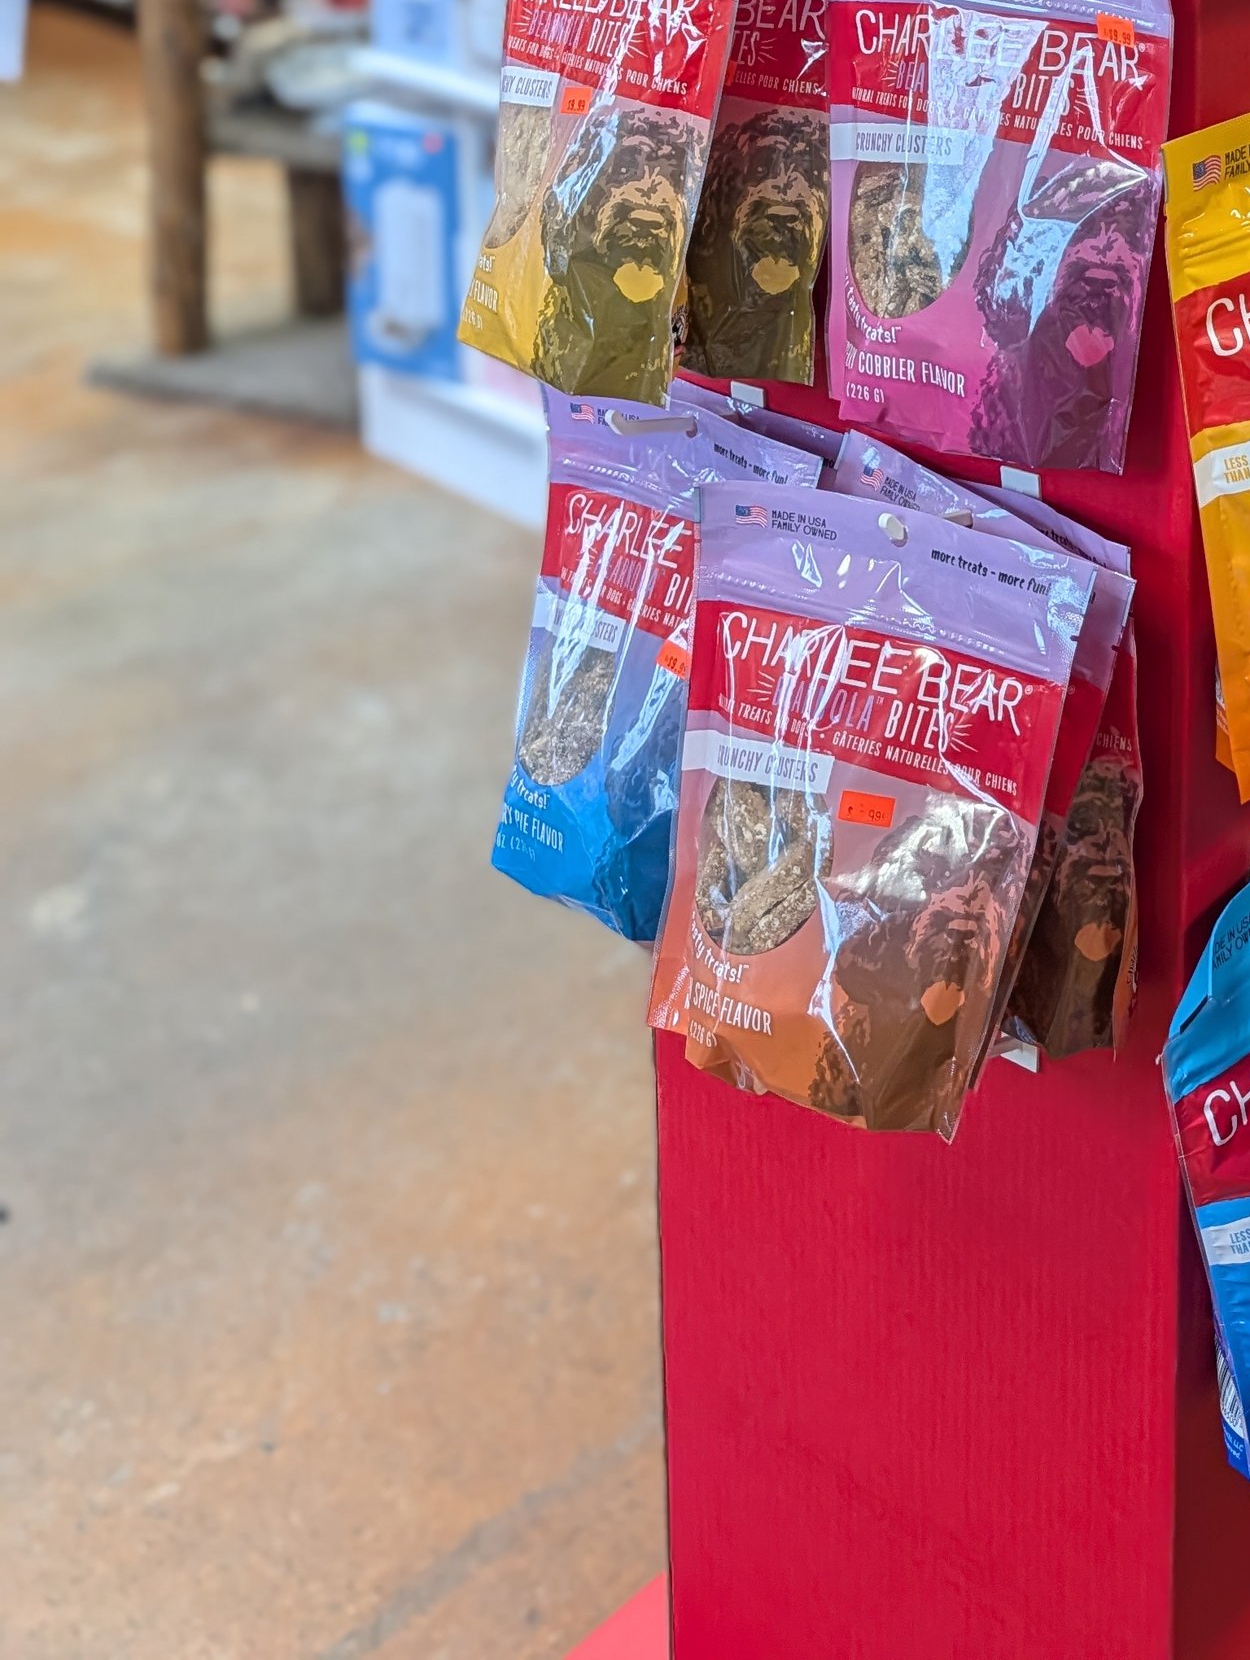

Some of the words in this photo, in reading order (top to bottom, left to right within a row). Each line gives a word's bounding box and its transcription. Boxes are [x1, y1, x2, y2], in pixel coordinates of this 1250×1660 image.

[1225, 147, 1247, 166] MADE
[1224, 158, 1250, 180] FAMILY
[858, 350, 915, 382] COBBLER
[922, 362, 965, 396] FLAVOR
[1223, 454, 1248, 471] LESS
[1224, 468, 1250, 484] THAN
[772, 510, 795, 522] MADE
[797, 514, 806, 523] IN
[808, 517, 826, 527] USA
